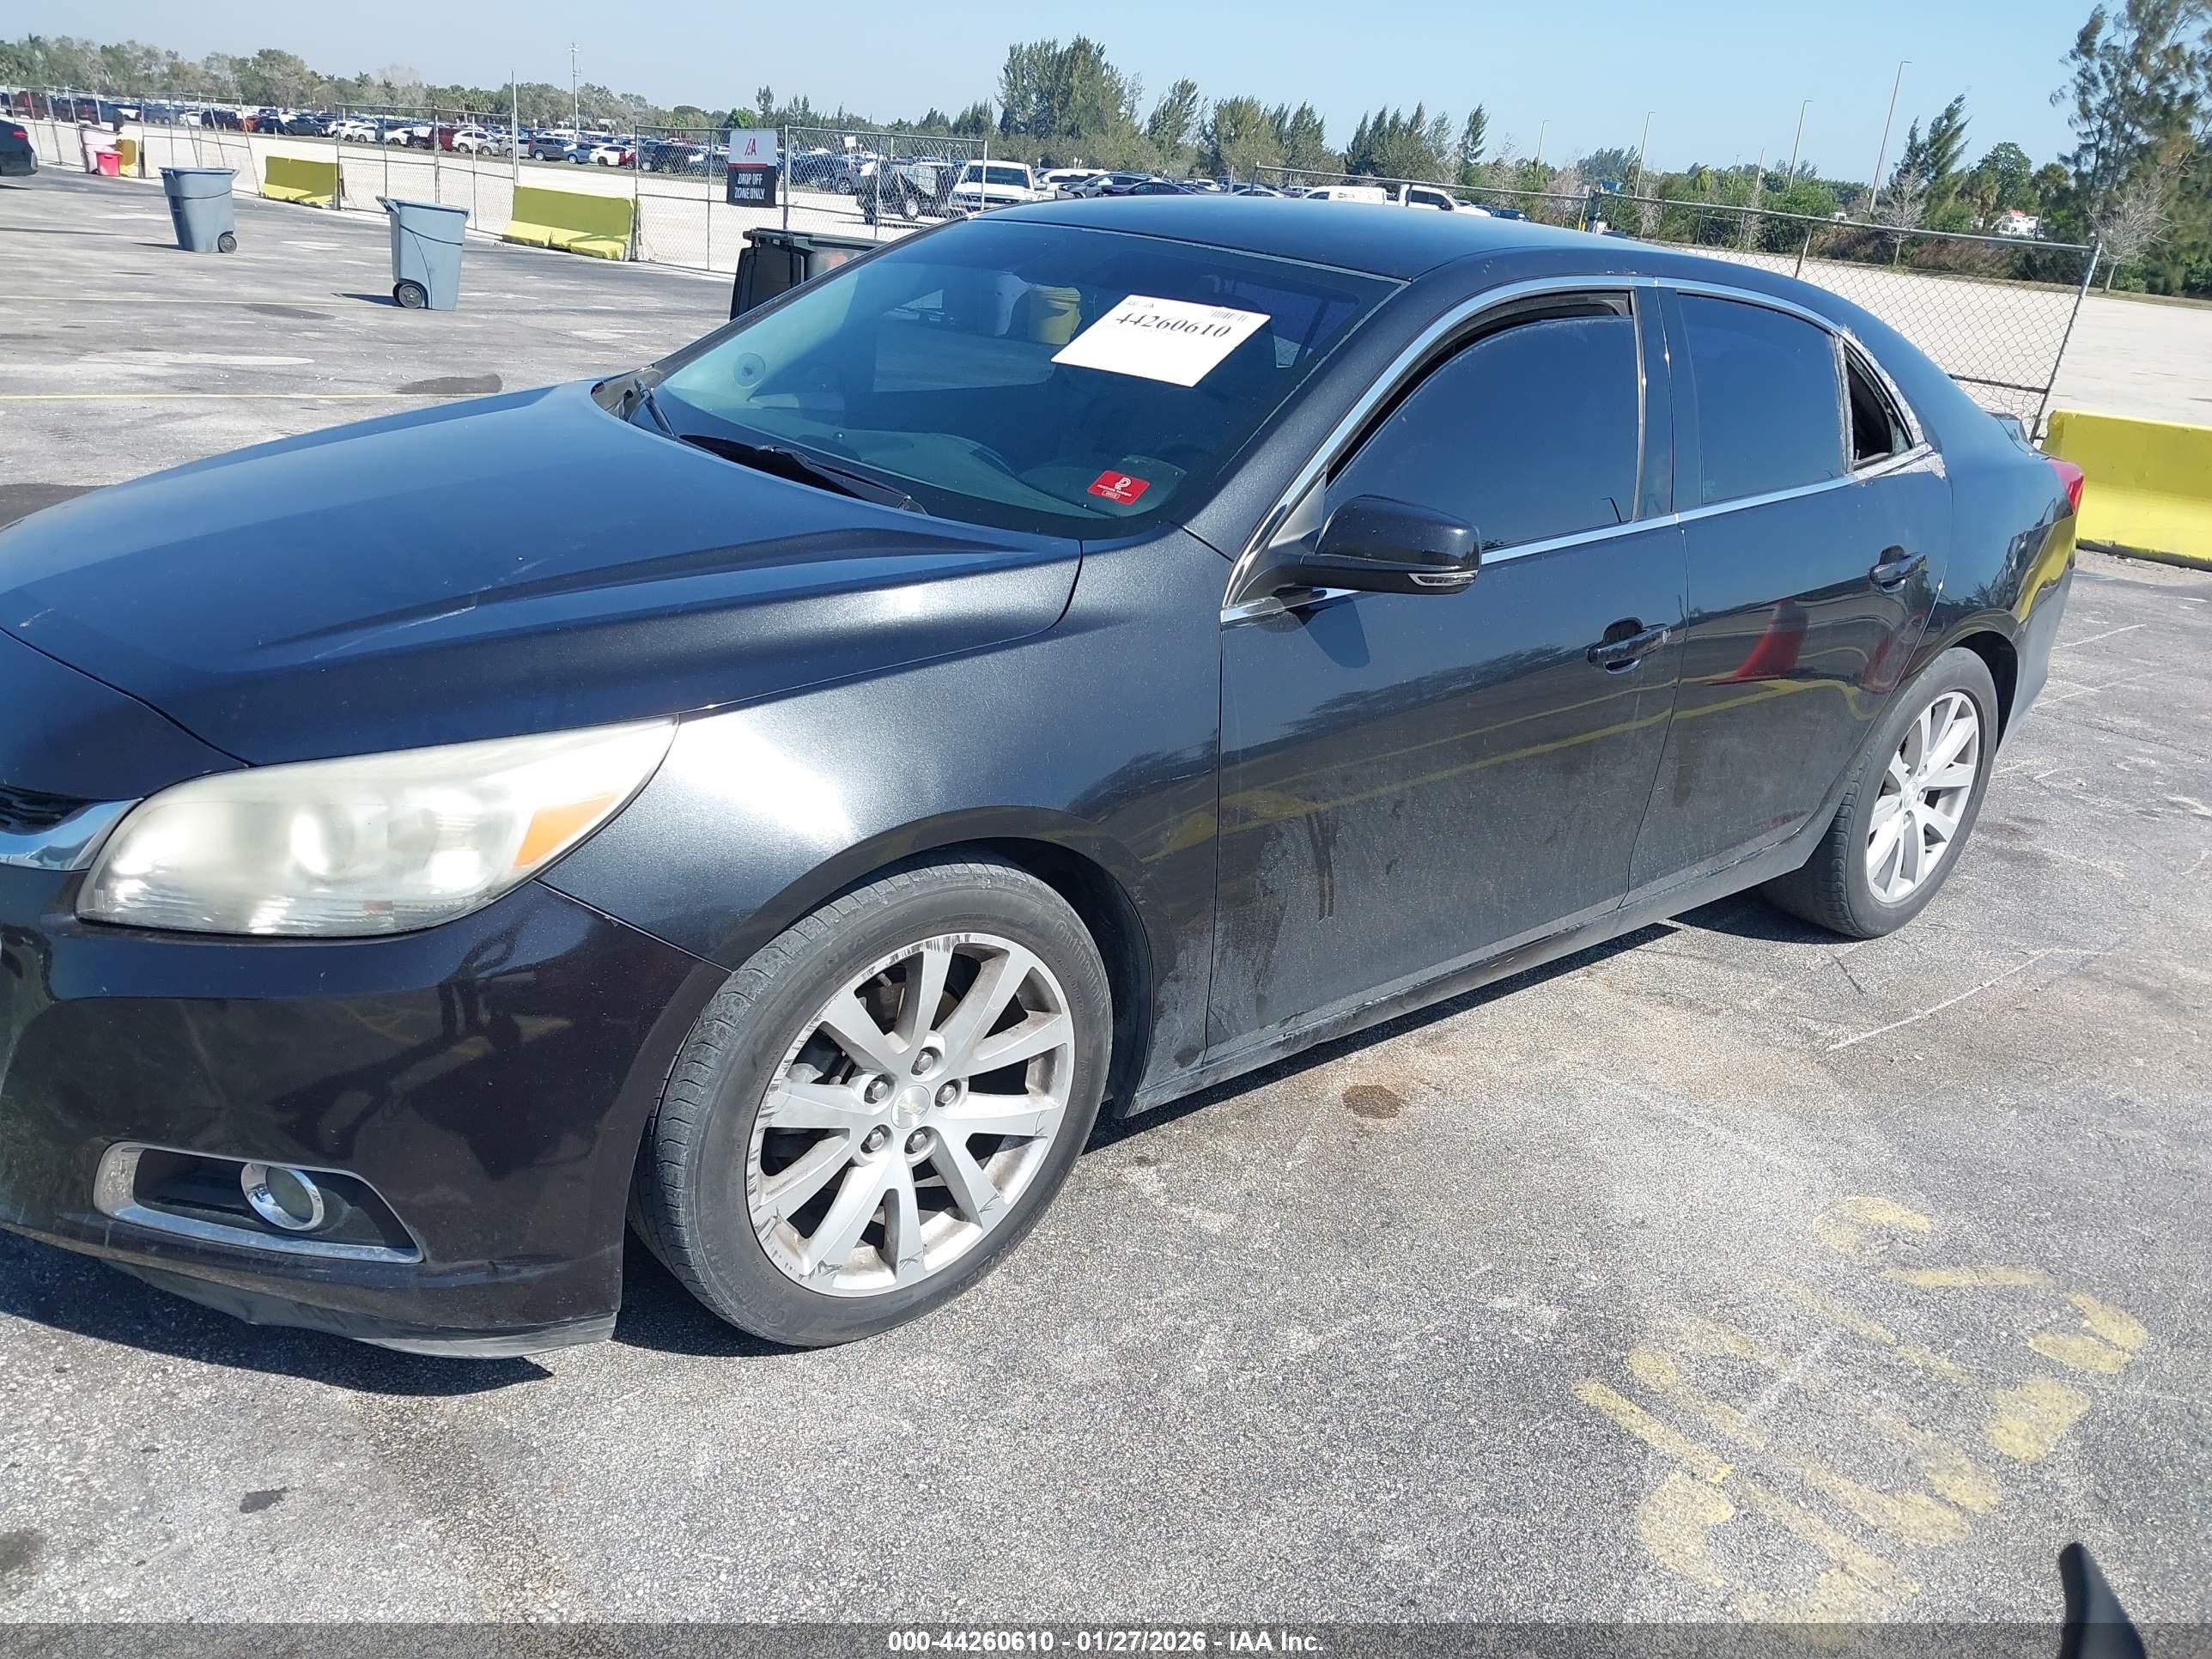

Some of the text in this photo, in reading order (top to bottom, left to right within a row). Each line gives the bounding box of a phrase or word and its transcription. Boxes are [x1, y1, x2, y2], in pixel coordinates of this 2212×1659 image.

[737, 173, 763, 186] DROP OFF
[734, 186, 766, 200] ZONE ONLY
[1115, 312, 1232, 338] 44260610
